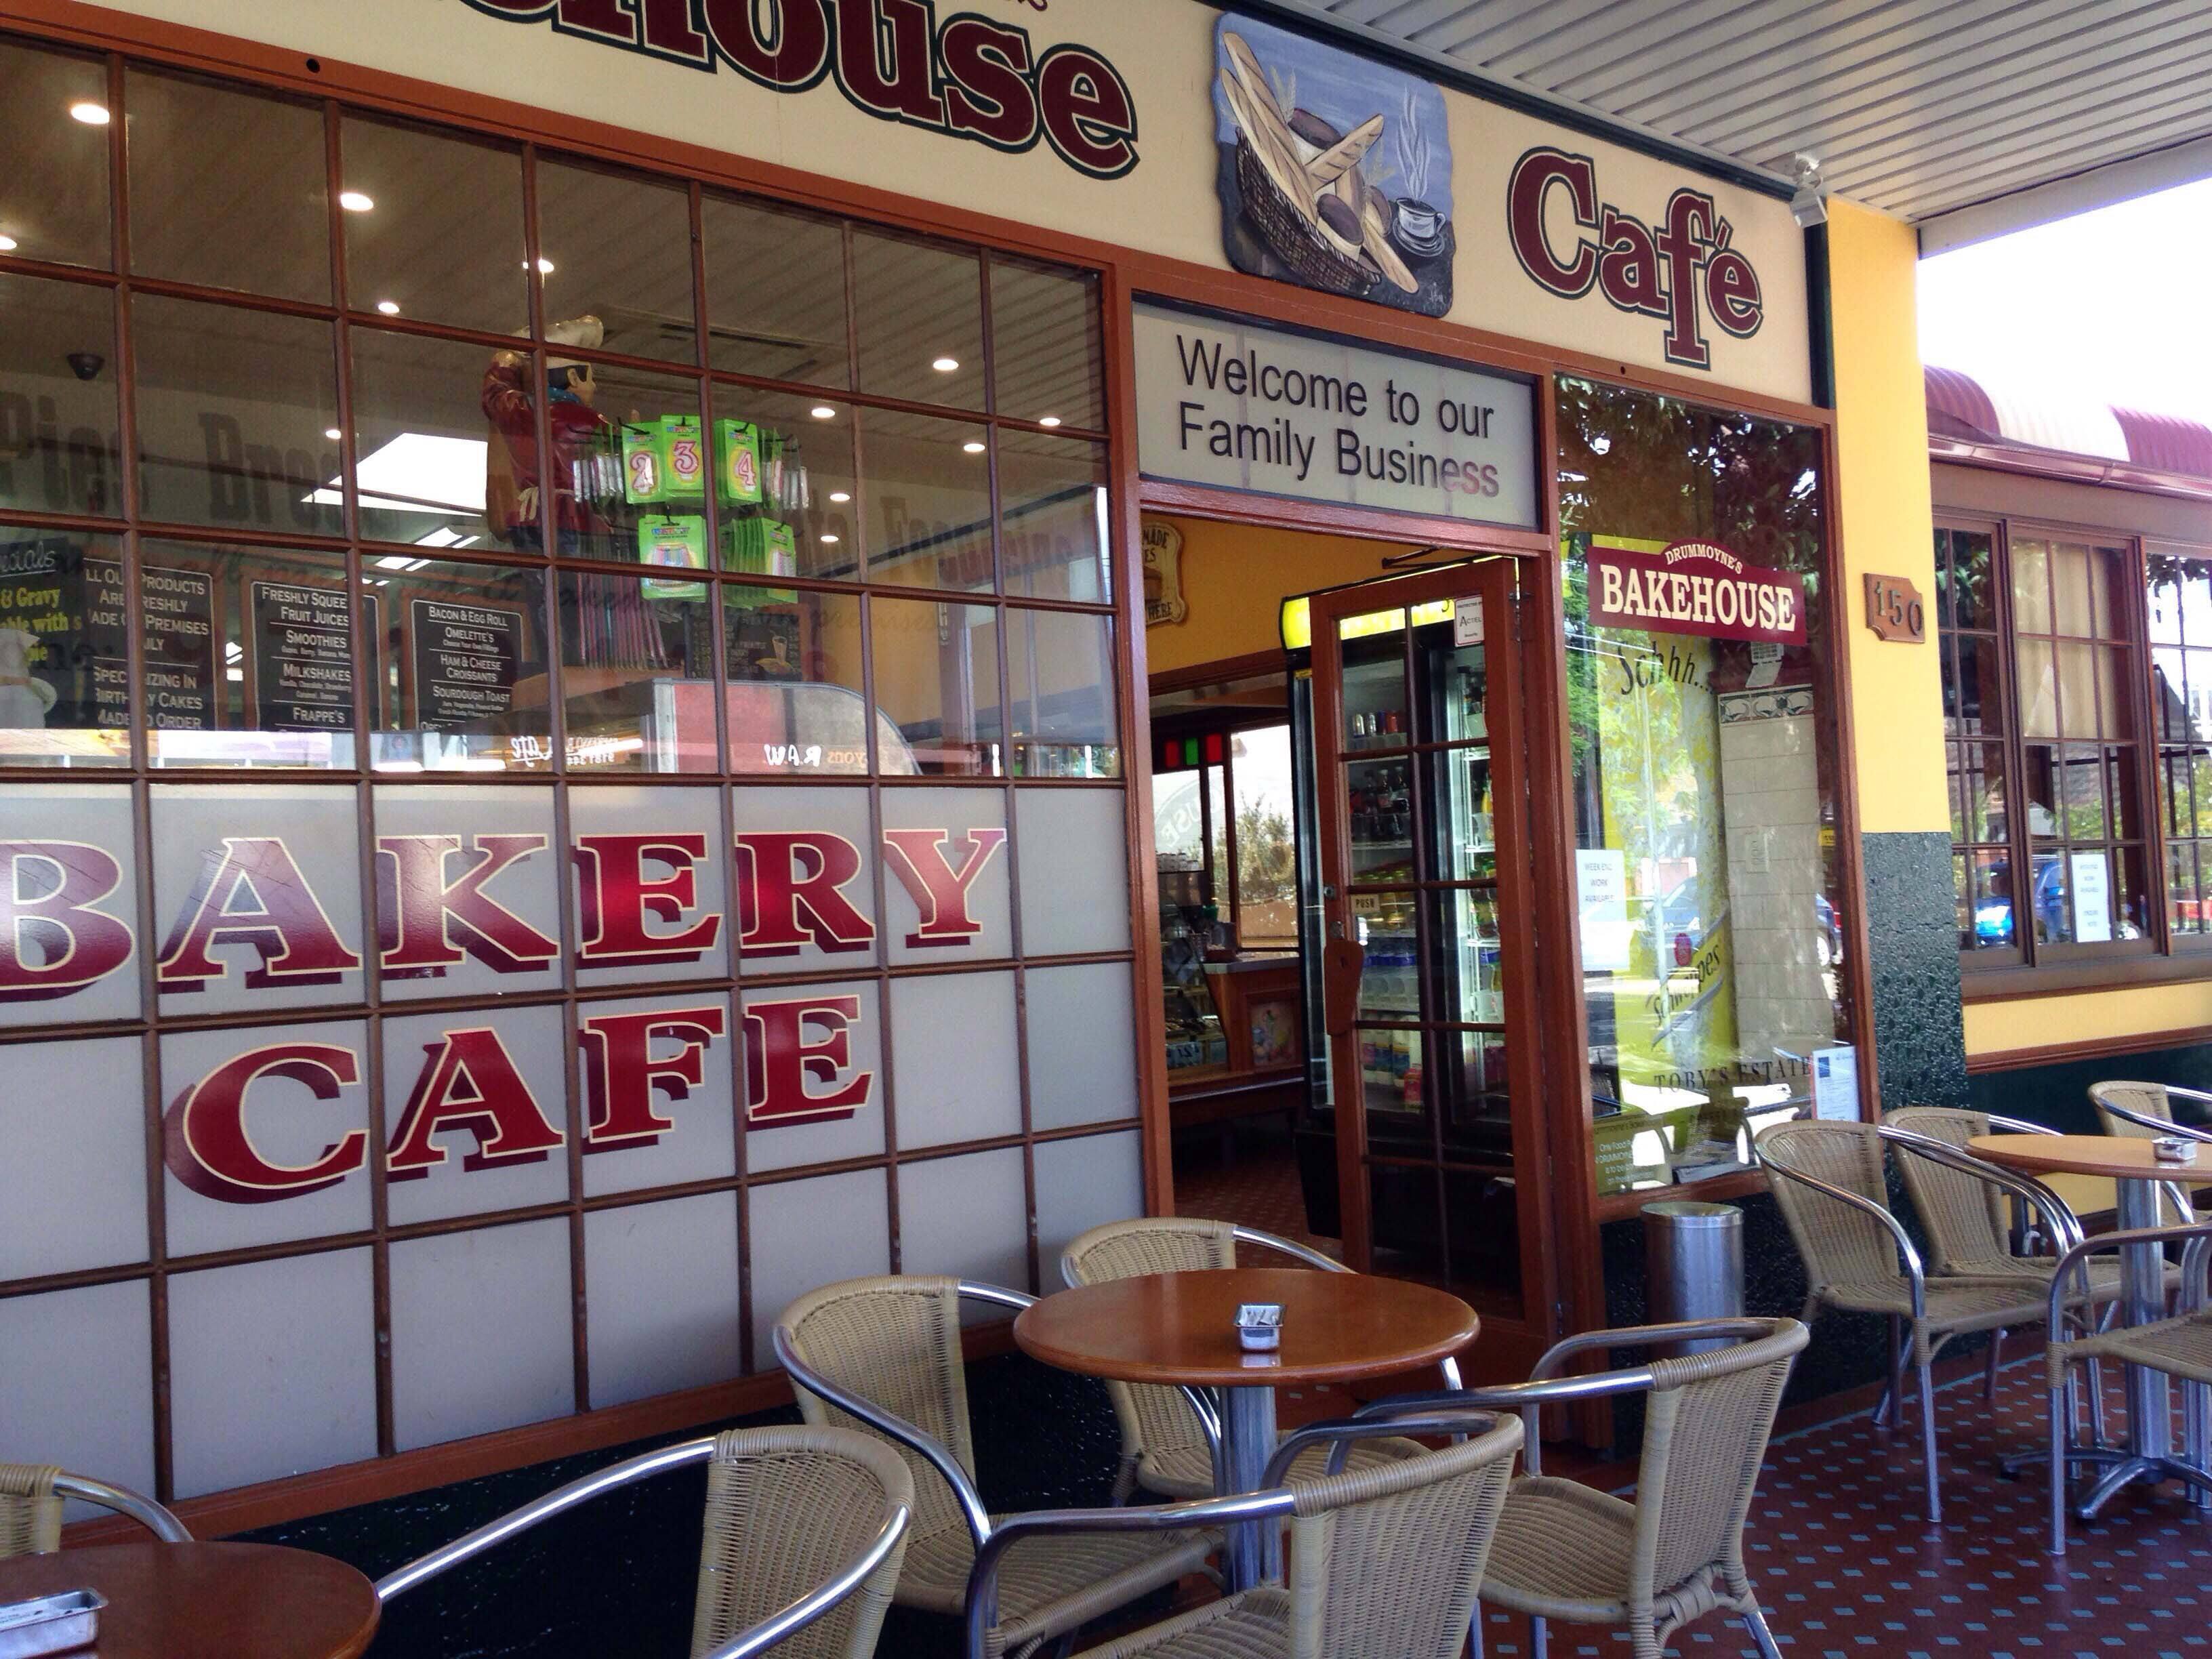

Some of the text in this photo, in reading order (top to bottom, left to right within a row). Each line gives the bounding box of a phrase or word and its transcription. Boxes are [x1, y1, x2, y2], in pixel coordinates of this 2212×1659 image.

[1176, 335, 1494, 439] Welcome to our
[674, 441, 699, 474] 3
[1180, 401, 1500, 498] Family Business
[737, 451, 756, 487] 4
[1665, 544, 1743, 575] DRUMMOYNE'S
[142, 596, 188, 613] RESHLY
[262, 586, 309, 605] FRESHLY
[1600, 564, 1796, 632] BAKEHOUSE
[281, 607, 349, 627] FRUIT JUICES
[428, 607, 459, 621] BACON
[468, 612, 485, 624] EGG
[487, 613, 508, 627] ROLL
[1874, 581, 1923, 636] 150
[145, 614, 209, 635] PREMISES
[286, 630, 347, 649] SMOOTHIES
[283, 663, 351, 682] MILKSHAKES
[441, 654, 460, 667] HAM
[469, 657, 502, 671] CHEESE
[184, 674, 197, 689] IN
[446, 667, 498, 682] CROISSANTS
[158, 692, 203, 710] CAKES
[433, 685, 510, 702] SOURDOUGH TOAST
[156, 712, 202, 729] ORDER
[0, 827, 1007, 1002] BAKERY
[1737, 1056, 1810, 1085] ESTATE
[165, 994, 875, 1204] CAFE
